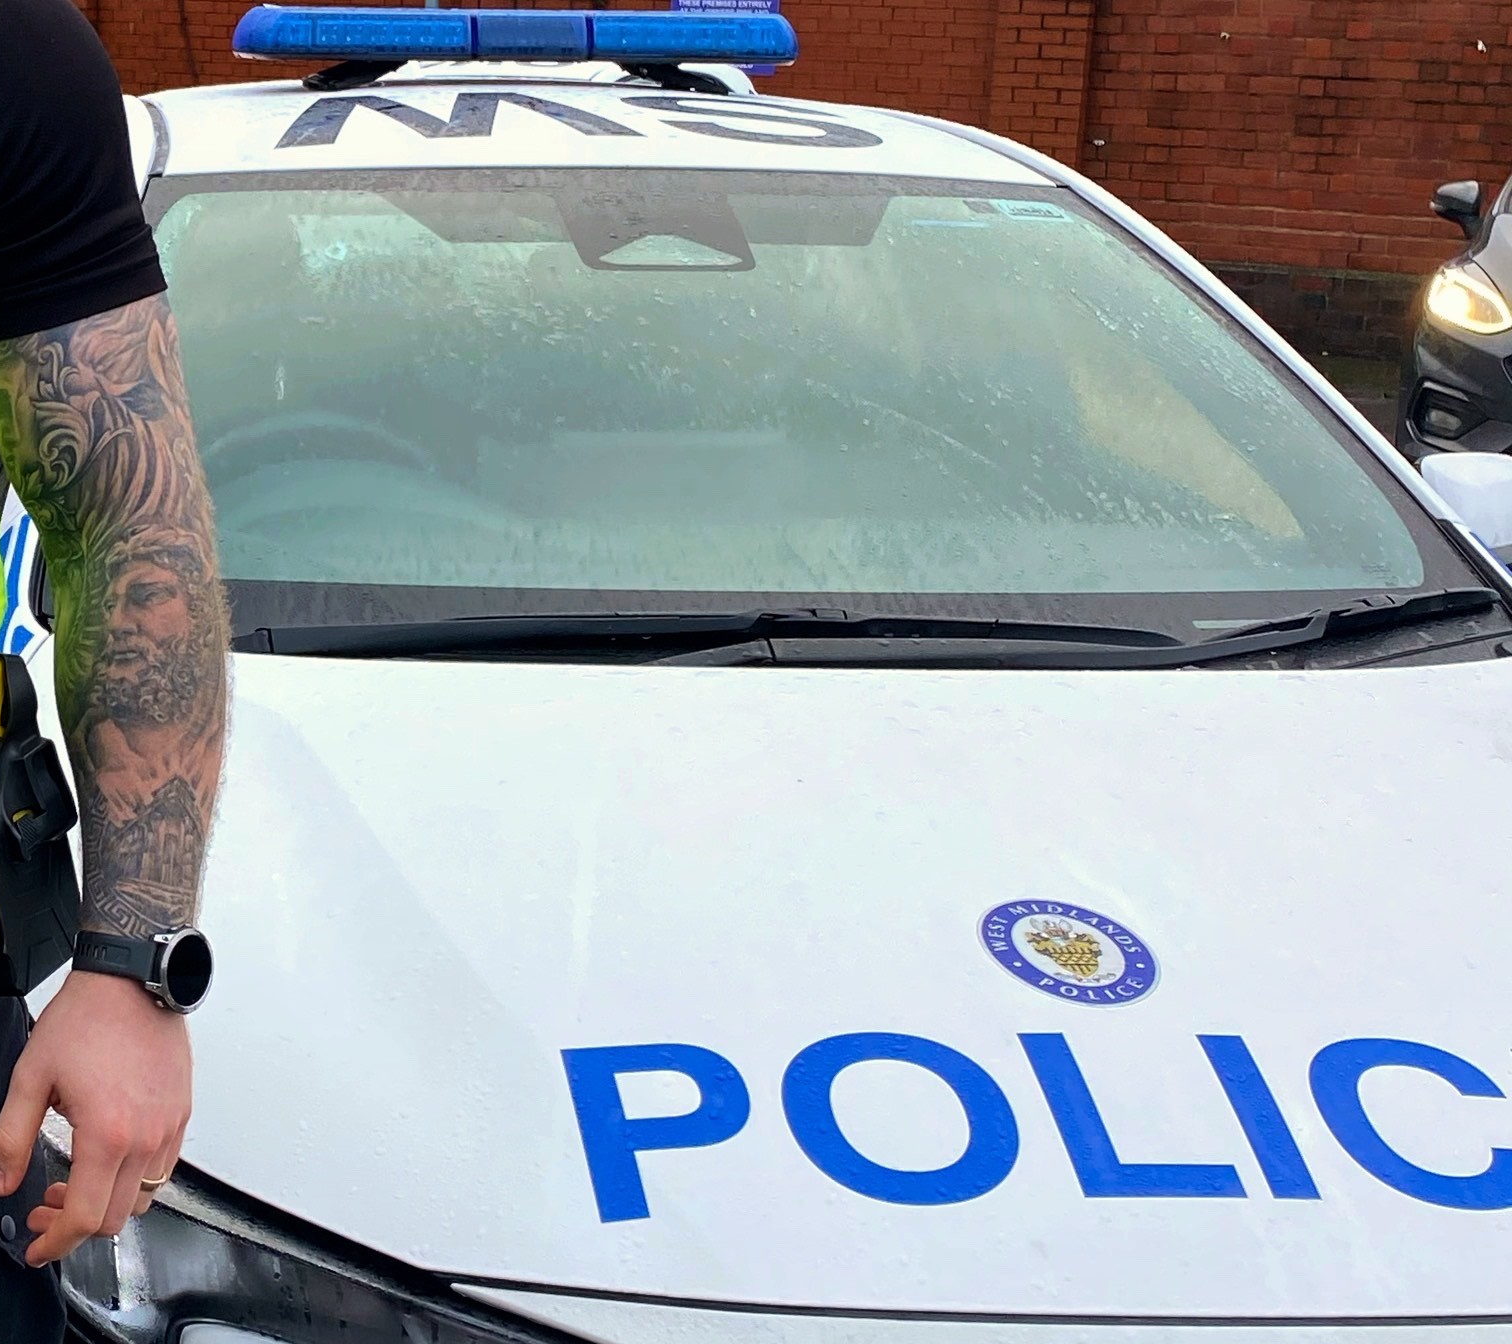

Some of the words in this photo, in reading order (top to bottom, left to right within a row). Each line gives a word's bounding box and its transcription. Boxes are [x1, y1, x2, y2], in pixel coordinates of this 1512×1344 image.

[678, 0, 700, 7] THESE
[701, 0, 736, 8] PREMISES
[738, 1, 772, 9] ENTIRELY
[988, 915, 1009, 952] WEST
[1007, 903, 1142, 954] MIDLANDS
[1038, 975, 1144, 1001] POLICE
[560, 1031, 1512, 1223] POLIC
